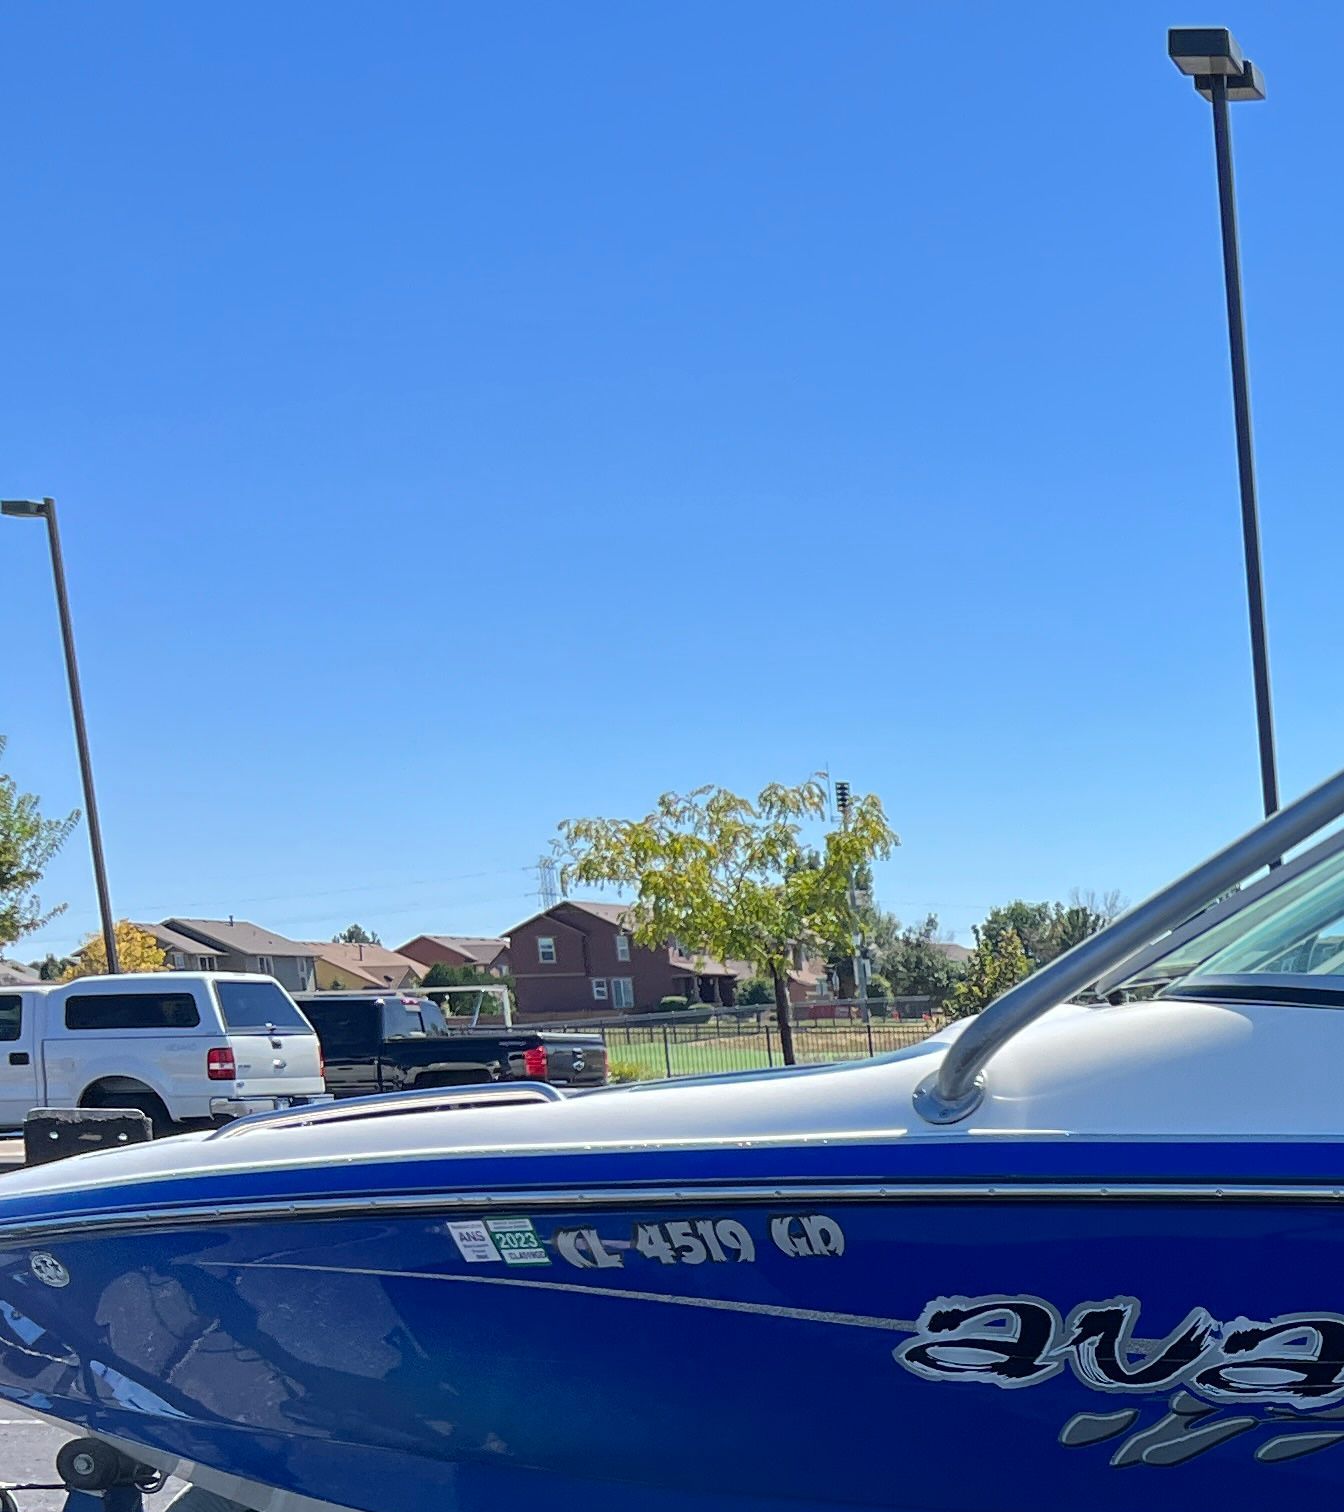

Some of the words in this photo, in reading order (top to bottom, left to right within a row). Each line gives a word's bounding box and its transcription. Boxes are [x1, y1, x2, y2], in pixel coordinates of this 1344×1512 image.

[459, 1230, 486, 1242] ANS
[495, 1232, 539, 1249] 2023
[637, 1219, 755, 1265] 4519
